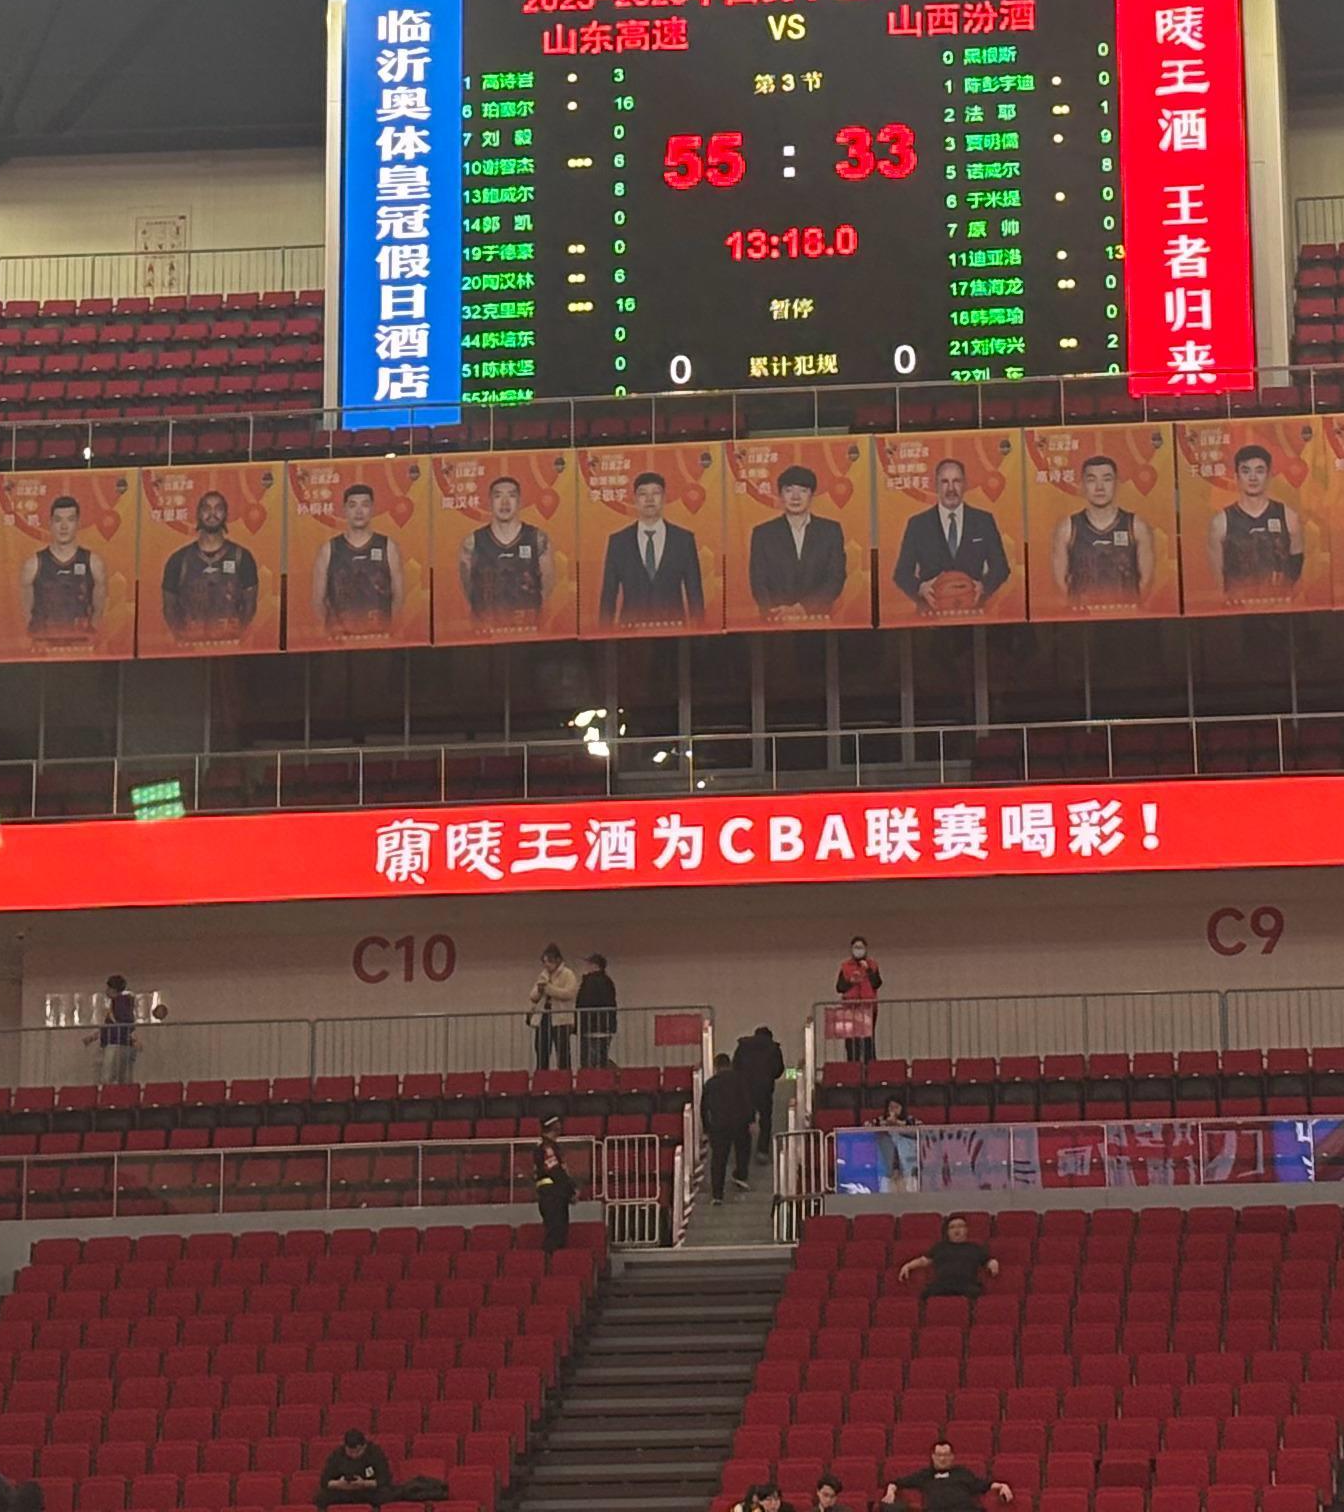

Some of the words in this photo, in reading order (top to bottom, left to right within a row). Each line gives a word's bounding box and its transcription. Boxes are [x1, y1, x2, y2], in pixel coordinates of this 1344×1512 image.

[768, 14, 806, 40] VS
[886, 0, 1036, 38] 山西汾酒
[542, 17, 689, 55] 山东高速
[942, 50, 954, 64] 0
[1098, 42, 1108, 56] 0
[464, 76, 471, 90] 1
[614, 68, 624, 82] 3
[945, 80, 952, 94] 1
[1099, 72, 1110, 85] 0
[615, 96, 634, 110] 16
[944, 108, 955, 122] 2
[1100, 100, 1108, 114] 1
[464, 134, 472, 146] 7
[614, 125, 624, 139] 0
[944, 137, 956, 151] 3
[614, 154, 624, 168] 6
[663, 131, 746, 190] 55
[834, 122, 918, 181] 33
[946, 166, 956, 180] 5
[1102, 158, 1112, 172] 8
[614, 183, 624, 196] 8
[946, 194, 957, 208] 6
[1103, 187, 1114, 200] 0
[376, 8, 432, 401] 临沂奥体皇冠假日酒店
[614, 210, 625, 224] 0
[947, 224, 958, 238] 7
[1104, 216, 1114, 230] 0
[614, 240, 626, 254] 0
[1106, 244, 1126, 260] 13
[614, 269, 626, 282] 6
[1106, 275, 1116, 288] 0
[1162, 185, 1216, 387] 王者归来
[616, 298, 636, 312] 16
[770, 298, 814, 320] 暂停
[1107, 304, 1118, 318] 0
[615, 327, 626, 341] 0
[1108, 334, 1118, 348] 2
[615, 356, 626, 370] 0
[670, 354, 692, 384] 0
[749, 354, 838, 377] 累计犯规
[894, 345, 916, 374] 0
[1206, 906, 1284, 956] C9
[353, 934, 456, 983] C10
